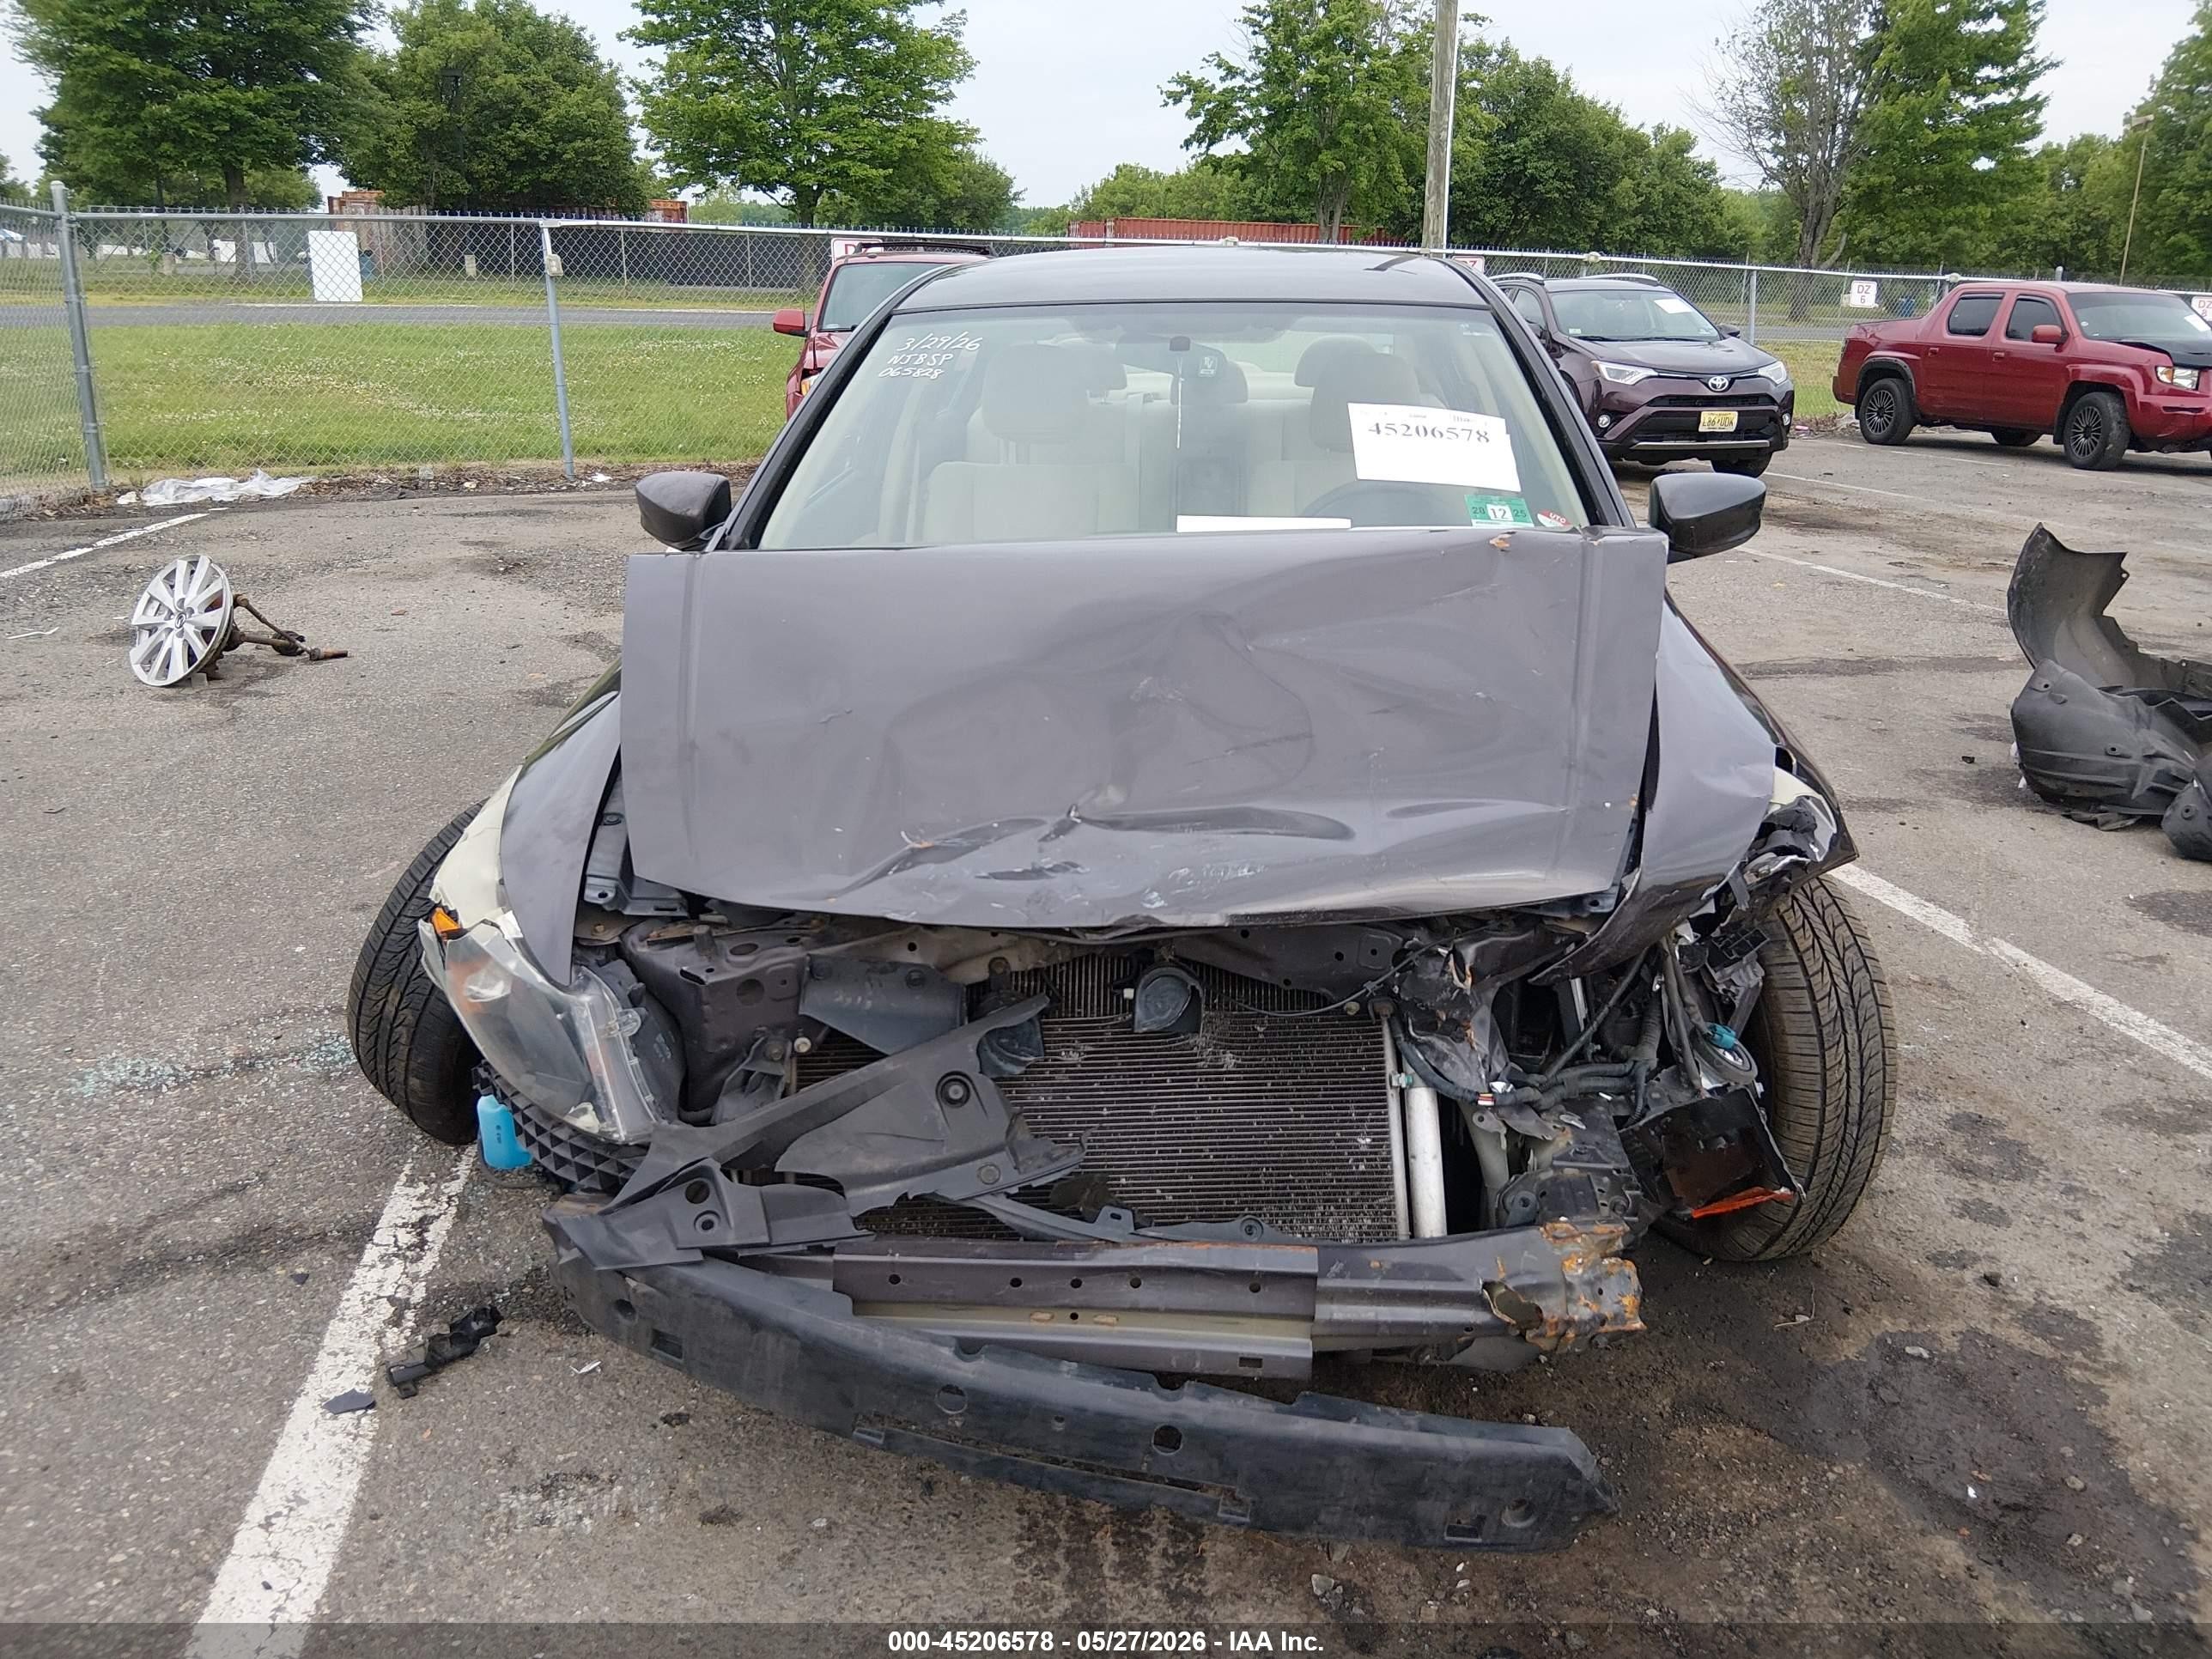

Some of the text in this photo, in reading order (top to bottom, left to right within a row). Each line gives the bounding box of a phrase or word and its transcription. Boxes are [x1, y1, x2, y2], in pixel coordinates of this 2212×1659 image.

[1856, 284, 1872, 295] DZ
[1860, 295, 1866, 304] 6
[896, 331, 983, 352] 3/29/26
[878, 367, 944, 380] 065828
[1368, 422, 1490, 443] 45206578
[1490, 507, 1510, 520] 12
[1513, 509, 1527, 519] 25
